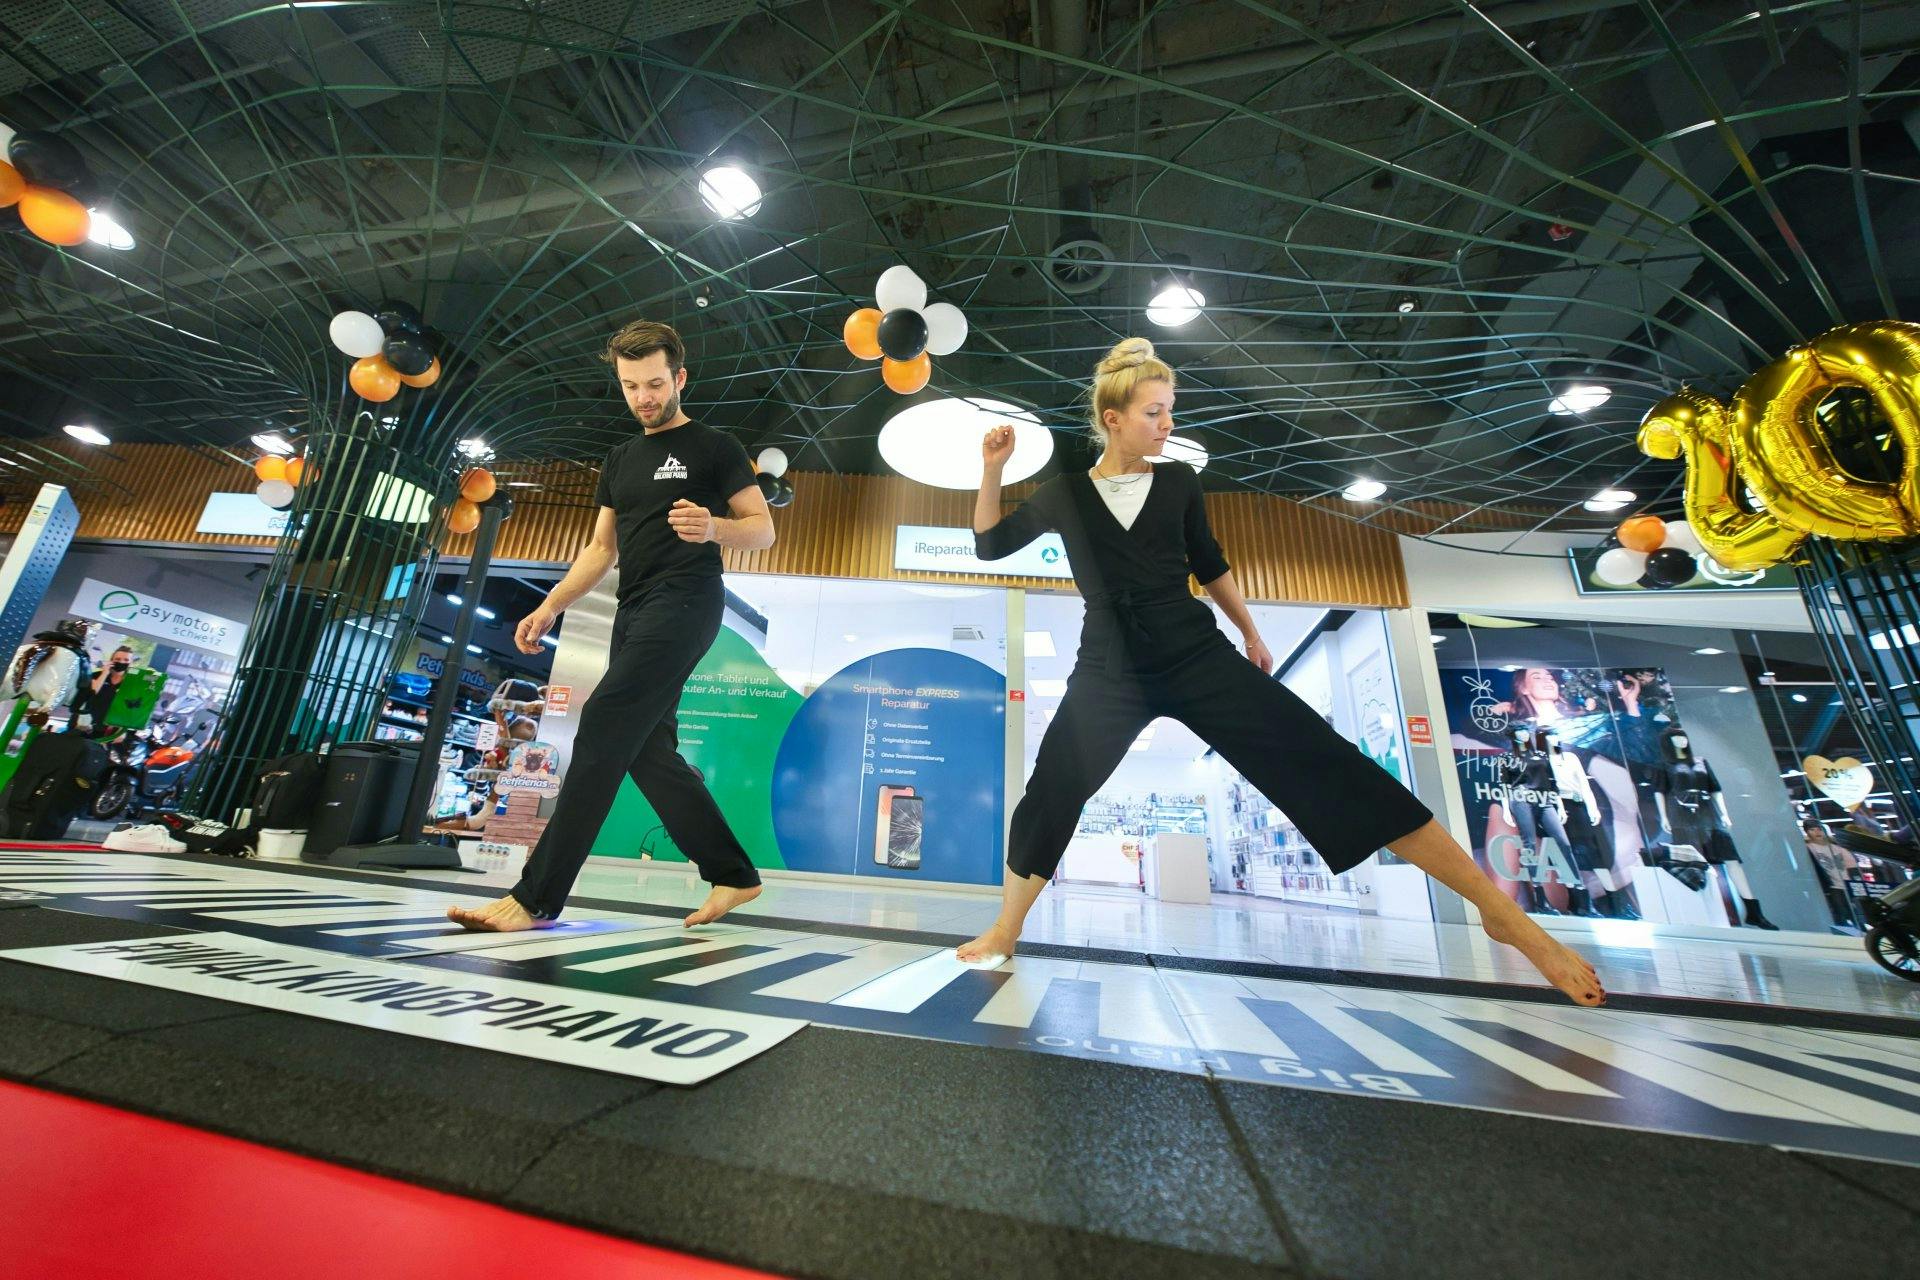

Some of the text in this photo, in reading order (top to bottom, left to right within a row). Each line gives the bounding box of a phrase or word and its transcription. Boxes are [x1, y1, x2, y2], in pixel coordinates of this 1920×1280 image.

[914, 541, 977, 557] iReparatu
[717, 673, 748, 684] Tablet
[750, 675, 769, 685] und
[728, 687, 747, 696] und
[749, 688, 788, 699] Verkauf
[852, 683, 961, 699] Smartphone EXPRESS
[881, 698, 931, 710] Reparatur
[1456, 748, 1528, 783] Happier
[1473, 781, 1560, 807] Holidays
[1486, 833, 1585, 888] C&A
[72, 943, 749, 1060] #WALKINGPIANO
